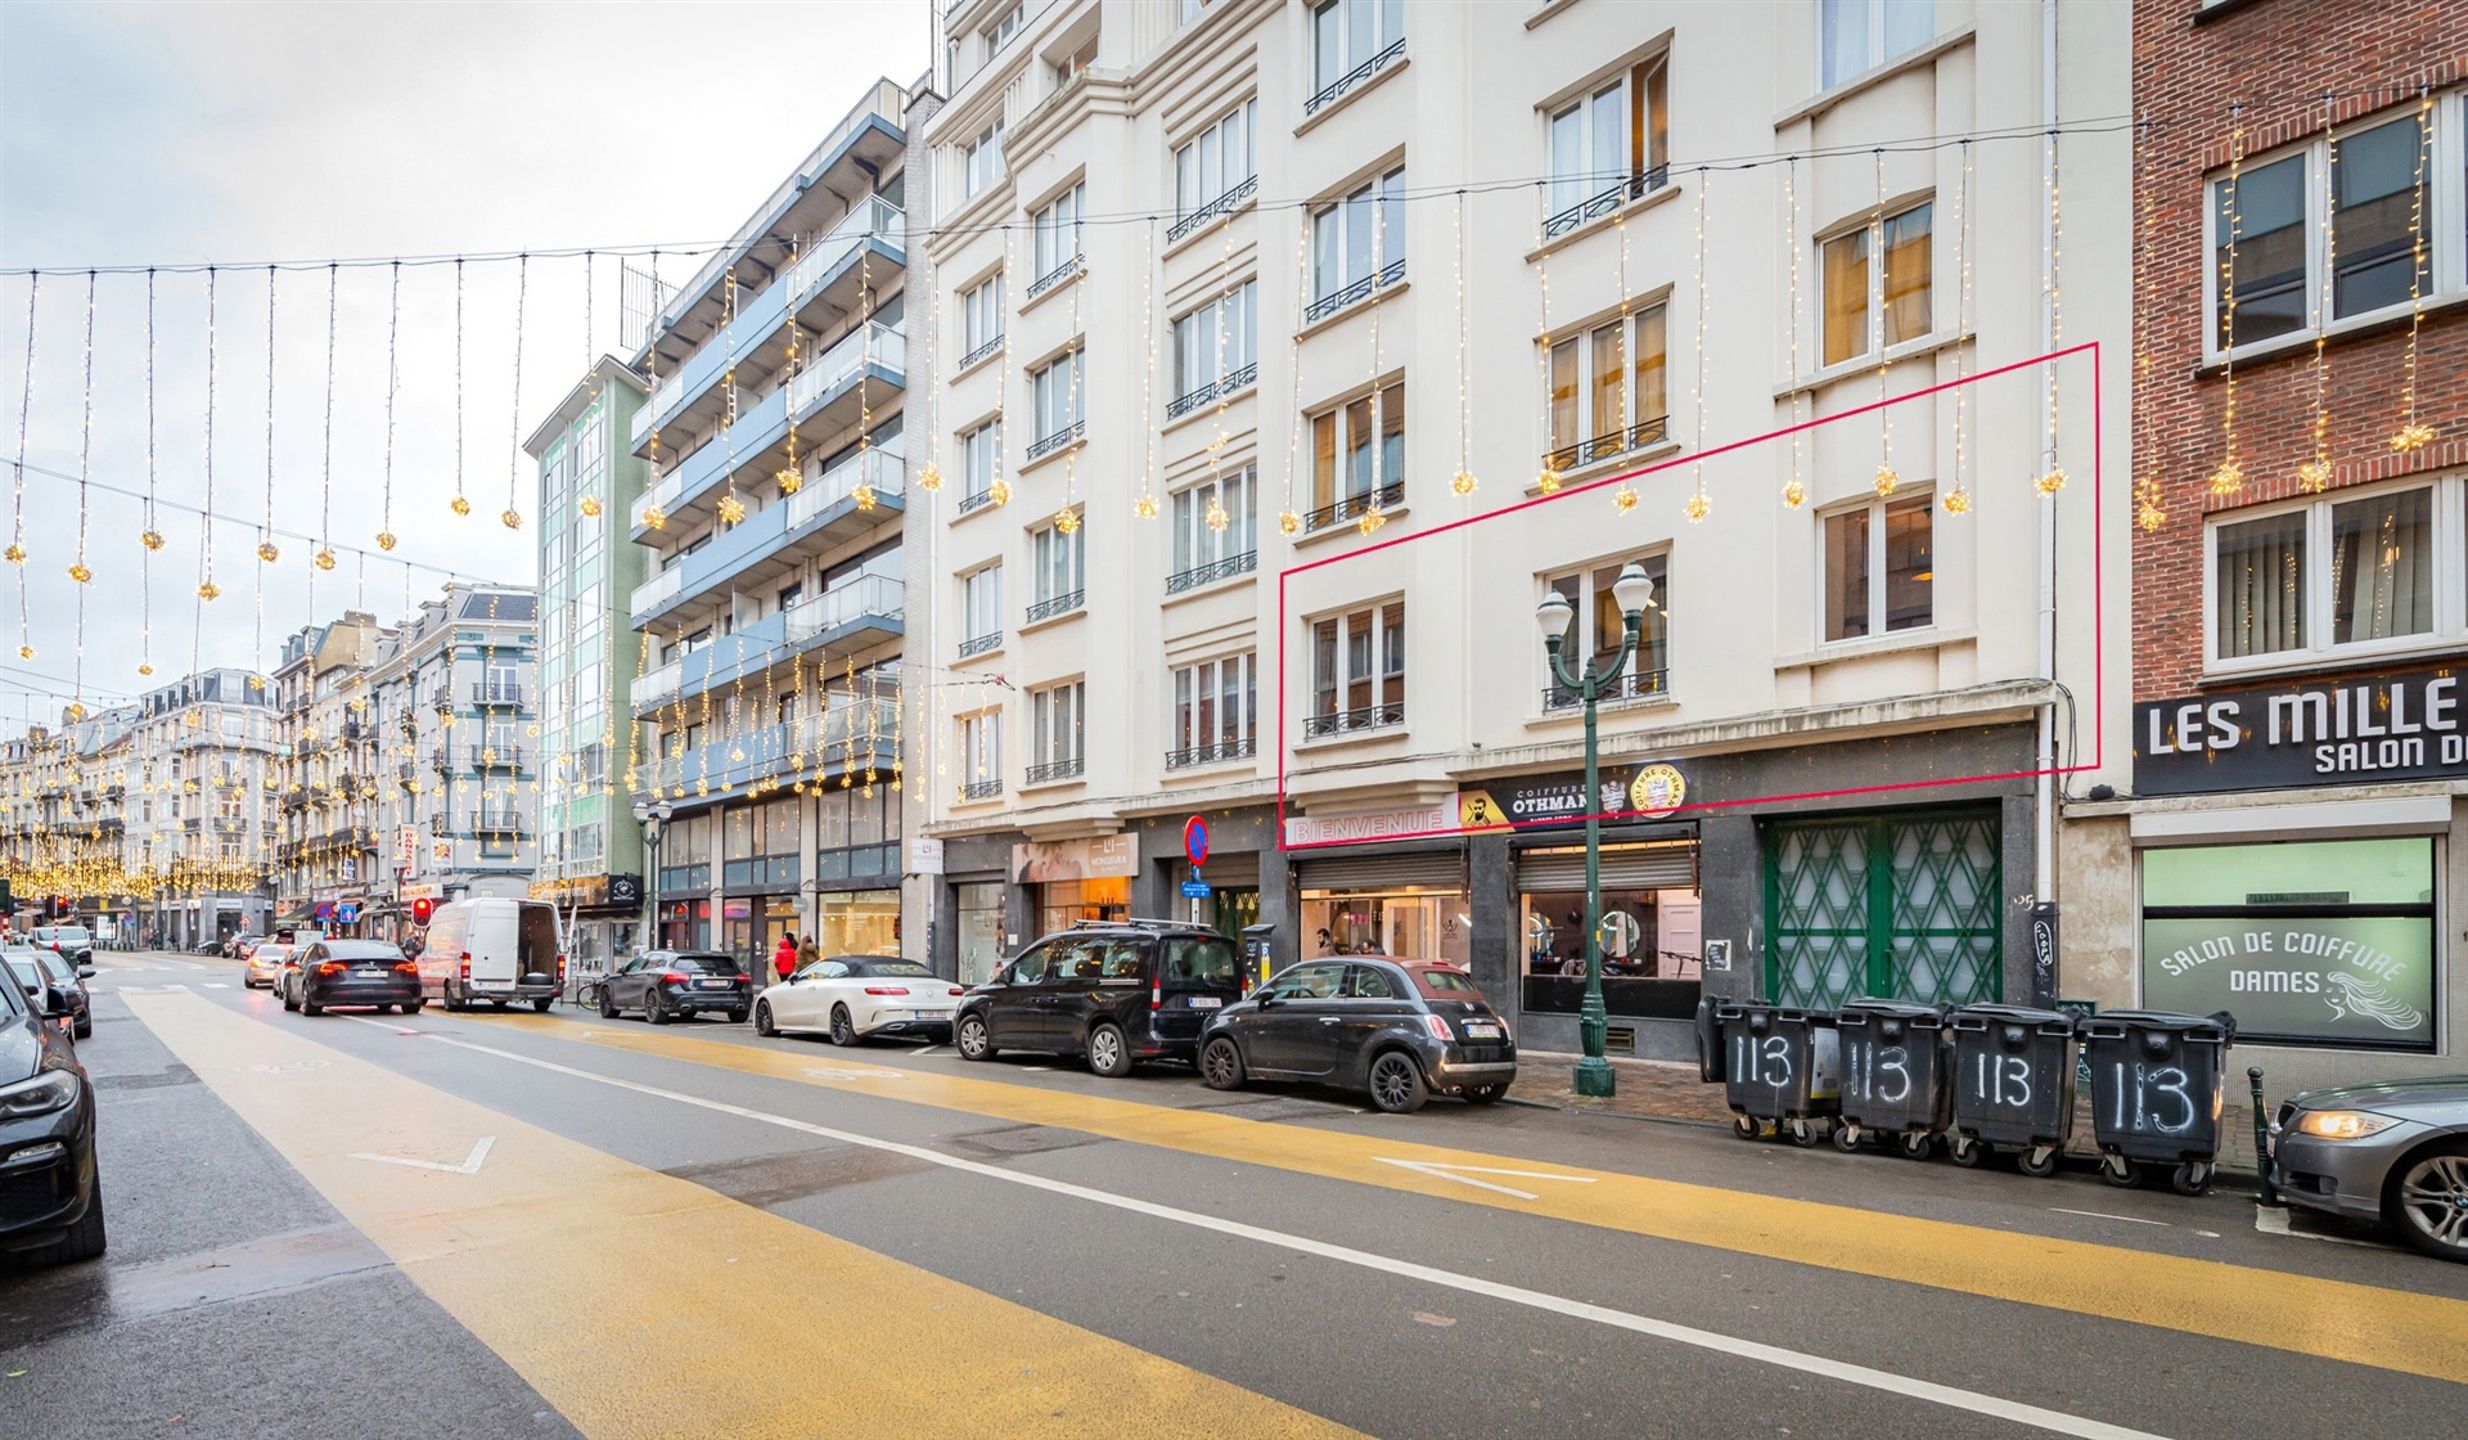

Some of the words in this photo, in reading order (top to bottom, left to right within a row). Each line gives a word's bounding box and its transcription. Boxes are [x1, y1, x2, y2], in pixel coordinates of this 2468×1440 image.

[2149, 701, 2240, 755] LES
[2316, 737, 2423, 773] SALON
[2442, 734, 2468, 765] D
[1512, 794, 1587, 814] OTHMAN
[1517, 784, 1587, 798] COIFFURE
[1635, 768, 1657, 811] COIFFURE
[1661, 768, 1681, 808] OTHMAN
[1294, 809, 1443, 843] BIENVENUE
[2160, 937, 2236, 977] SALON
[2244, 932, 2273, 953] DE
[2284, 931, 2408, 983] COIFFURE
[2230, 970, 2320, 994] DAMES
[1736, 1035, 1792, 1088] 113
[1850, 1041, 1911, 1103] 113
[1977, 1053, 2031, 1107] 113
[2114, 1062, 2194, 1133] 113
